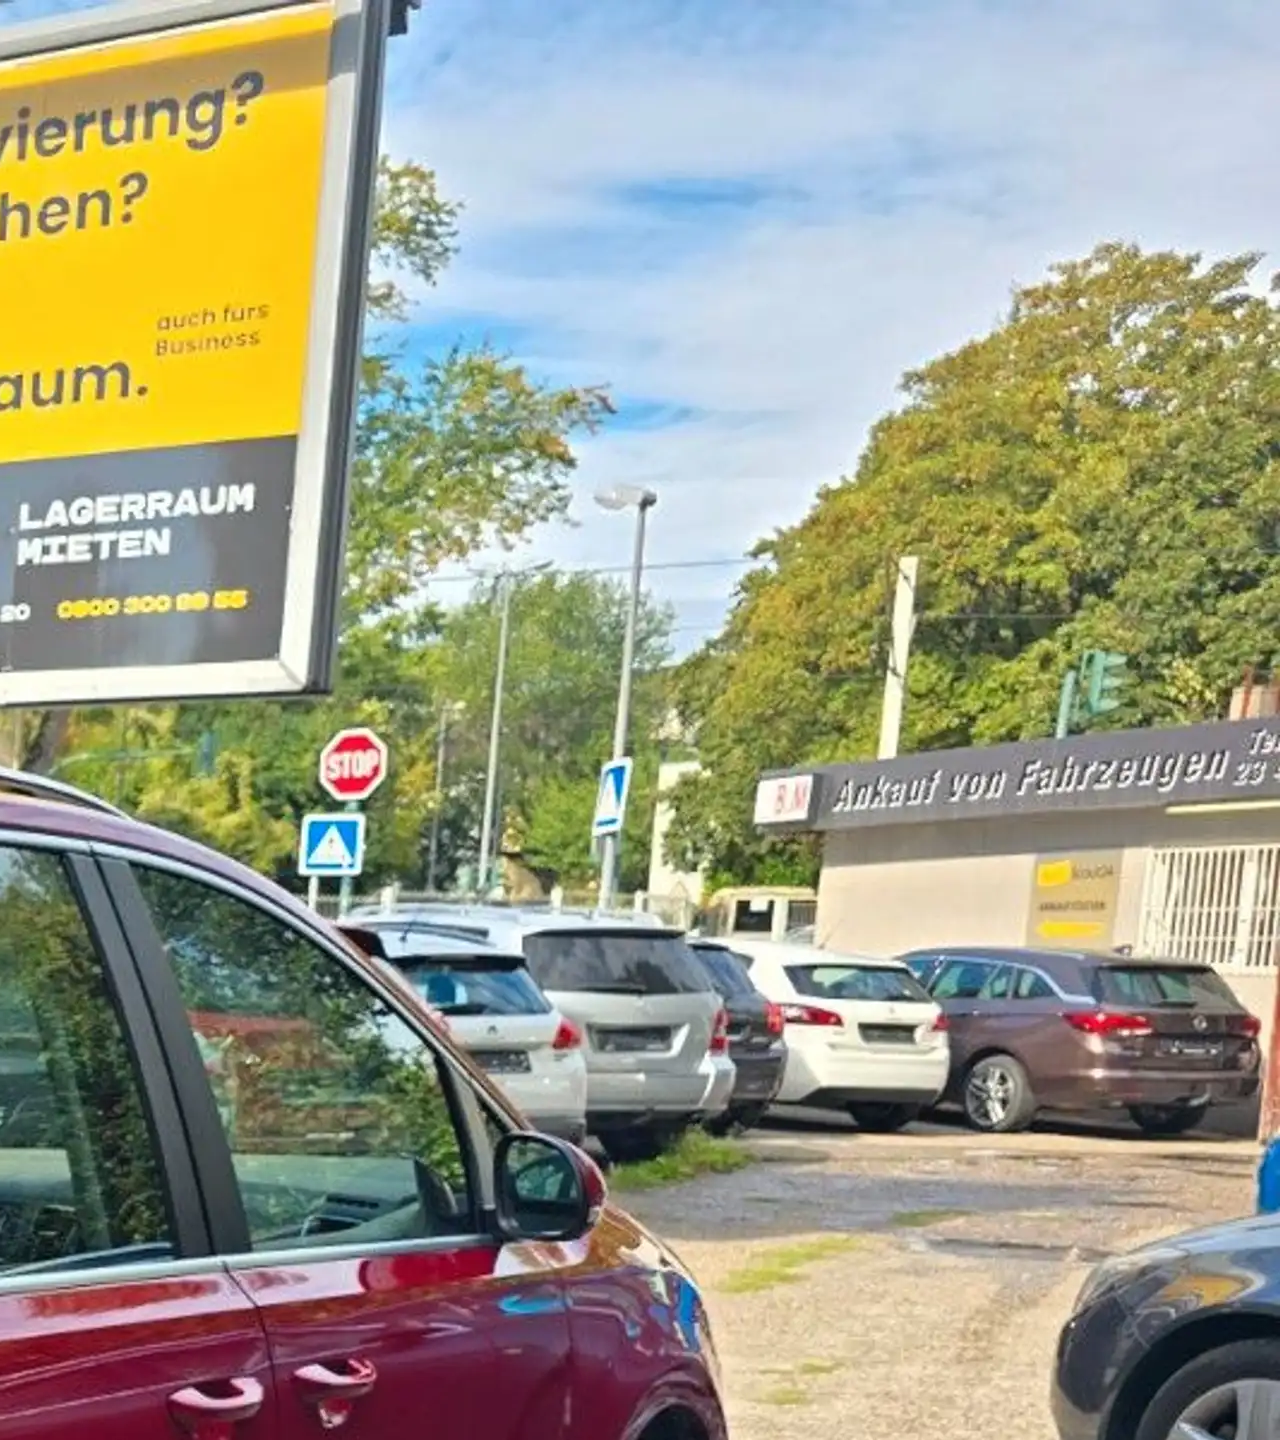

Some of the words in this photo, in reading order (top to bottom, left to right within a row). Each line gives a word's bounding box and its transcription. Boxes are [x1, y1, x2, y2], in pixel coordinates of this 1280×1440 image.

[156, 308, 217, 331] auch
[154, 328, 261, 357] Business
[18, 483, 256, 531] LAGERRAUM
[16, 528, 172, 567] MIETEN
[325, 749, 380, 781] STOP
[833, 769, 942, 813] Ankauf
[944, 769, 1008, 803] von
[1016, 748, 1230, 797] Fahrzeugen
